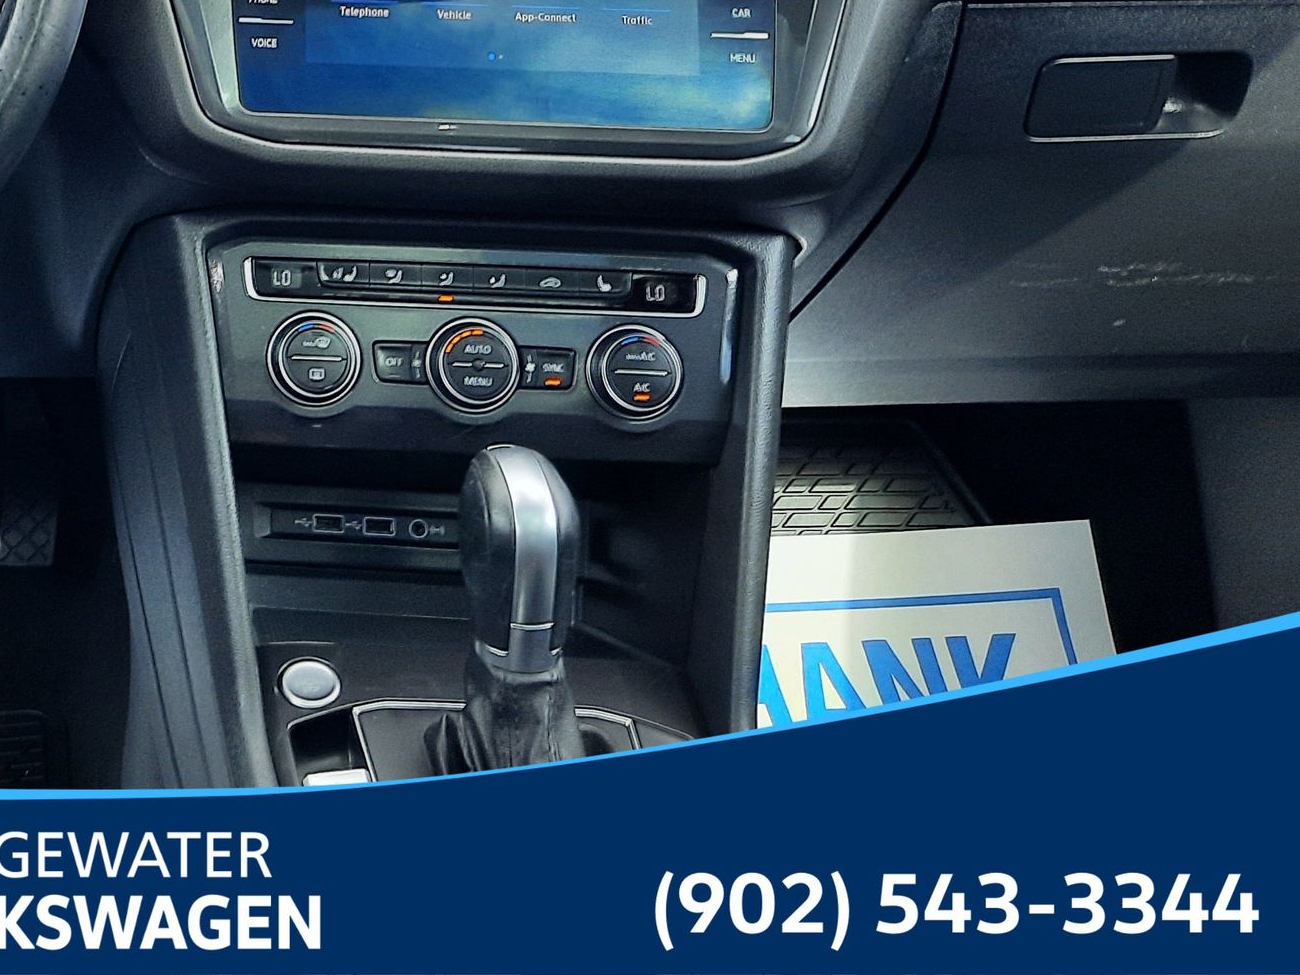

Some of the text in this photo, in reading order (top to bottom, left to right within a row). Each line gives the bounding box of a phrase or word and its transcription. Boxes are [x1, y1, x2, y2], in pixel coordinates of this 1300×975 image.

[339, 6, 390, 18] Telephone
[437, 9, 472, 20] Vehicle
[732, 8, 751, 18] CAR
[515, 12, 577, 24] App-Connect
[622, 15, 653, 26] Traffic
[251, 38, 278, 49] VOICE
[730, 53, 756, 63] MENU
[464, 345, 492, 355] AUTO
[385, 357, 403, 367] OFF
[464, 377, 493, 386] MENU
